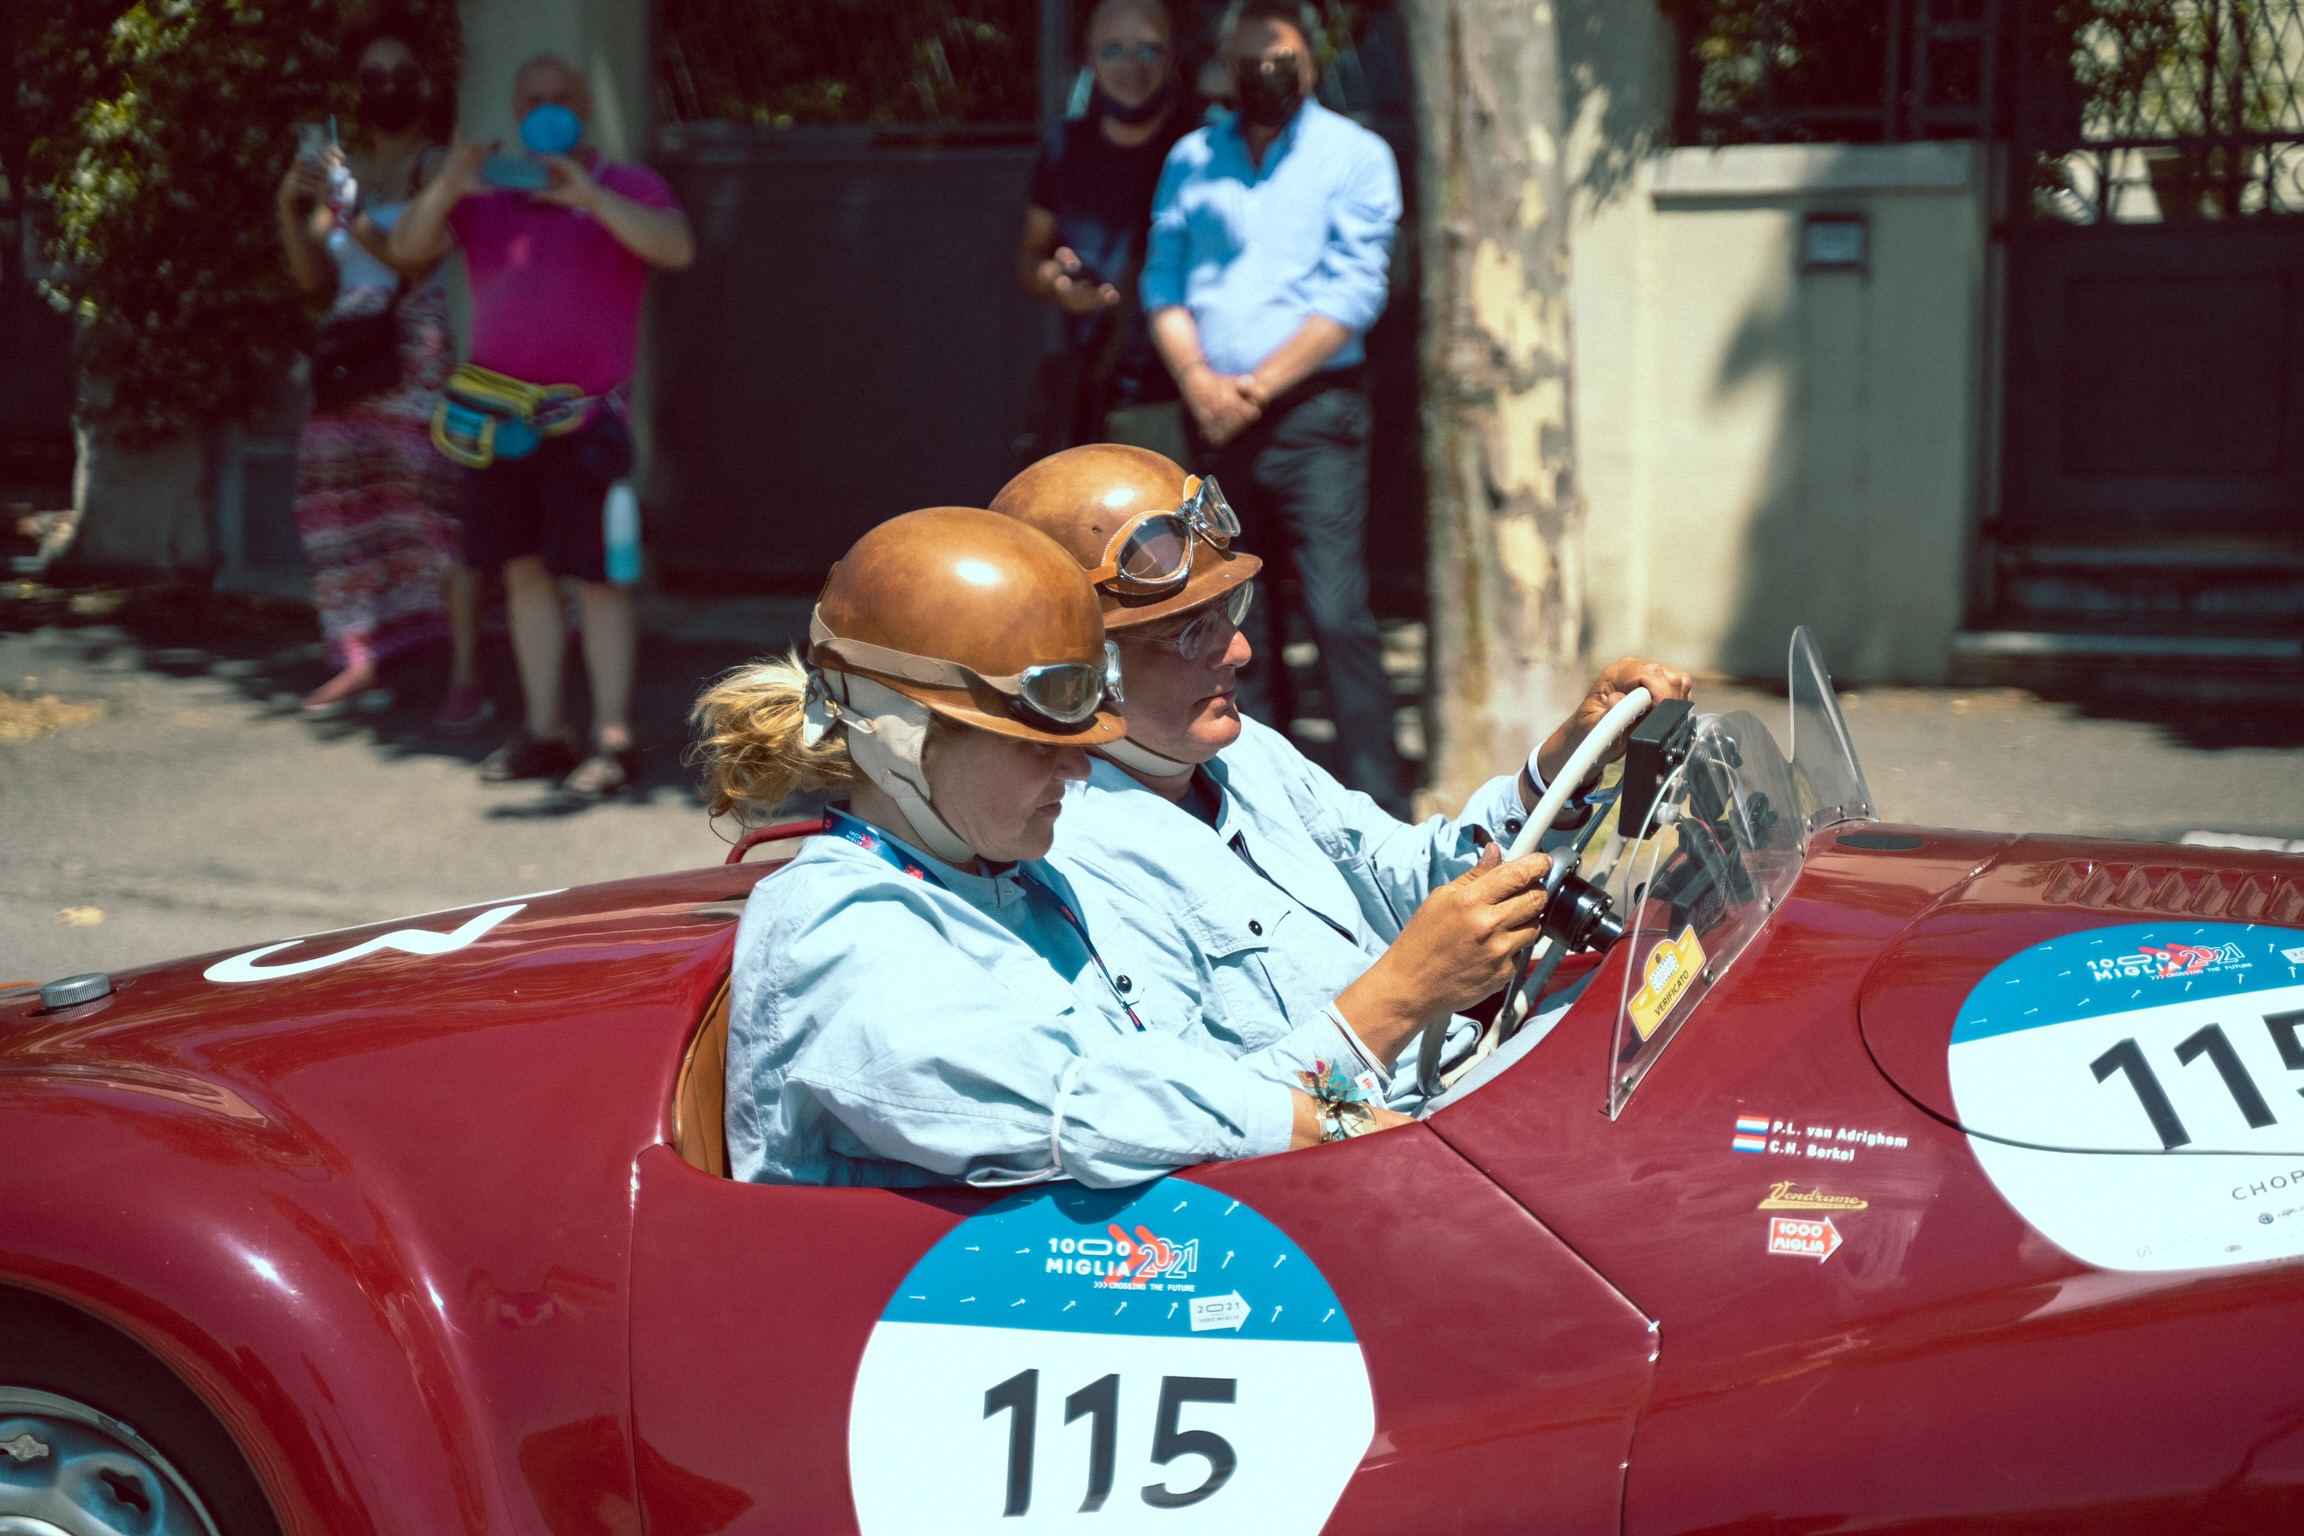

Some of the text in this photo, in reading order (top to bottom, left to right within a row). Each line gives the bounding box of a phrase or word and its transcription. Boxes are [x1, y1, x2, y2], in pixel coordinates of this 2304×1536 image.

[2086, 952, 2171, 970] 1000
[2179, 942, 2245, 968] 2021
[2093, 961, 2182, 981] MIGLIA
[1655, 970, 1689, 1016] VERIFICATO
[1772, 1121, 1801, 1135] P.L.
[1807, 1126, 1833, 1138] van
[1770, 1140, 1801, 1155] C.H.
[1778, 1222, 1823, 1237] 1000
[1048, 1238, 1131, 1257] 1000
[1773, 1237, 1825, 1253] MIGLIA
[1046, 1257, 1131, 1277] MIGLIA
[1136, 1237, 1199, 1279] 2021
[1109, 1282, 1195, 1292] CROSSING THE FUTURE
[983, 1368, 1238, 1517] 115
